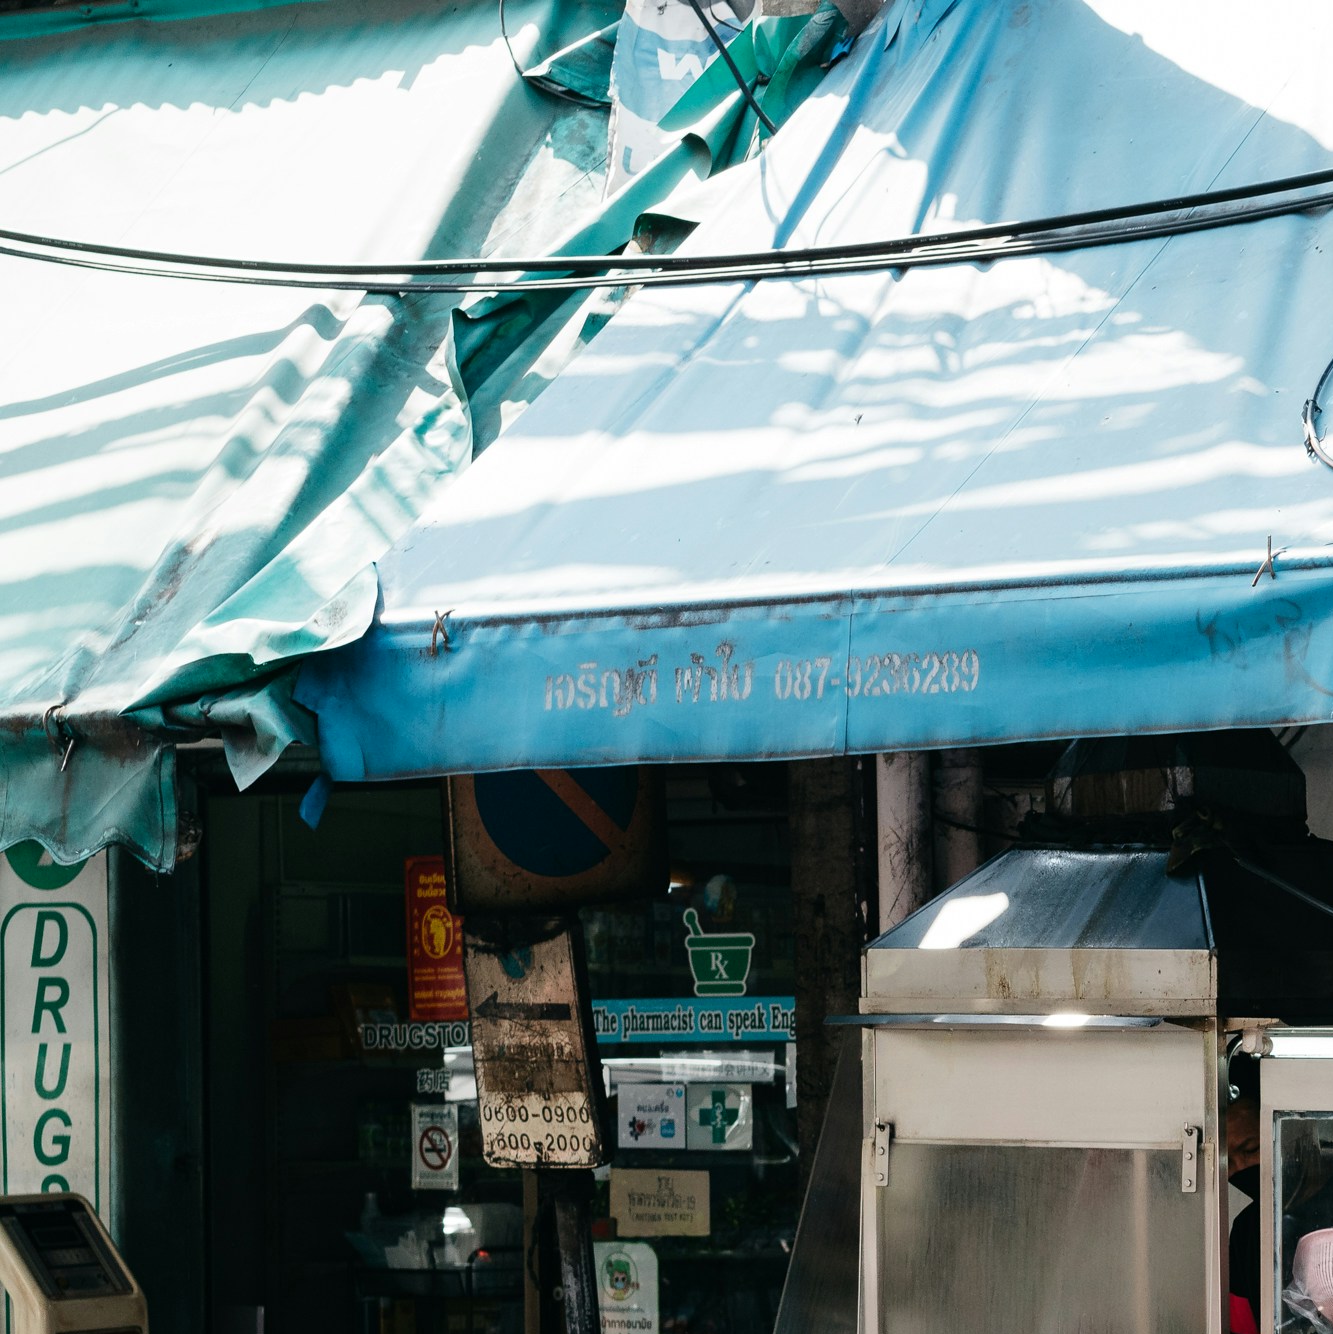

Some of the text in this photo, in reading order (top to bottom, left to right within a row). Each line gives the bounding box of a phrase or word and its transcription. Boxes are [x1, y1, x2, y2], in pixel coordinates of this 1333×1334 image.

[774, 649, 980, 701] 087-9236289
[363, 1022, 474, 1049] DRUGSTO
[593, 1007, 618, 1034] The
[622, 1006, 695, 1041] pharmacist
[699, 1011, 724, 1031] can
[727, 1003, 766, 1040] speak
[416, 1067, 451, 1094] 药店
[483, 1104, 590, 1124] 0600-0900
